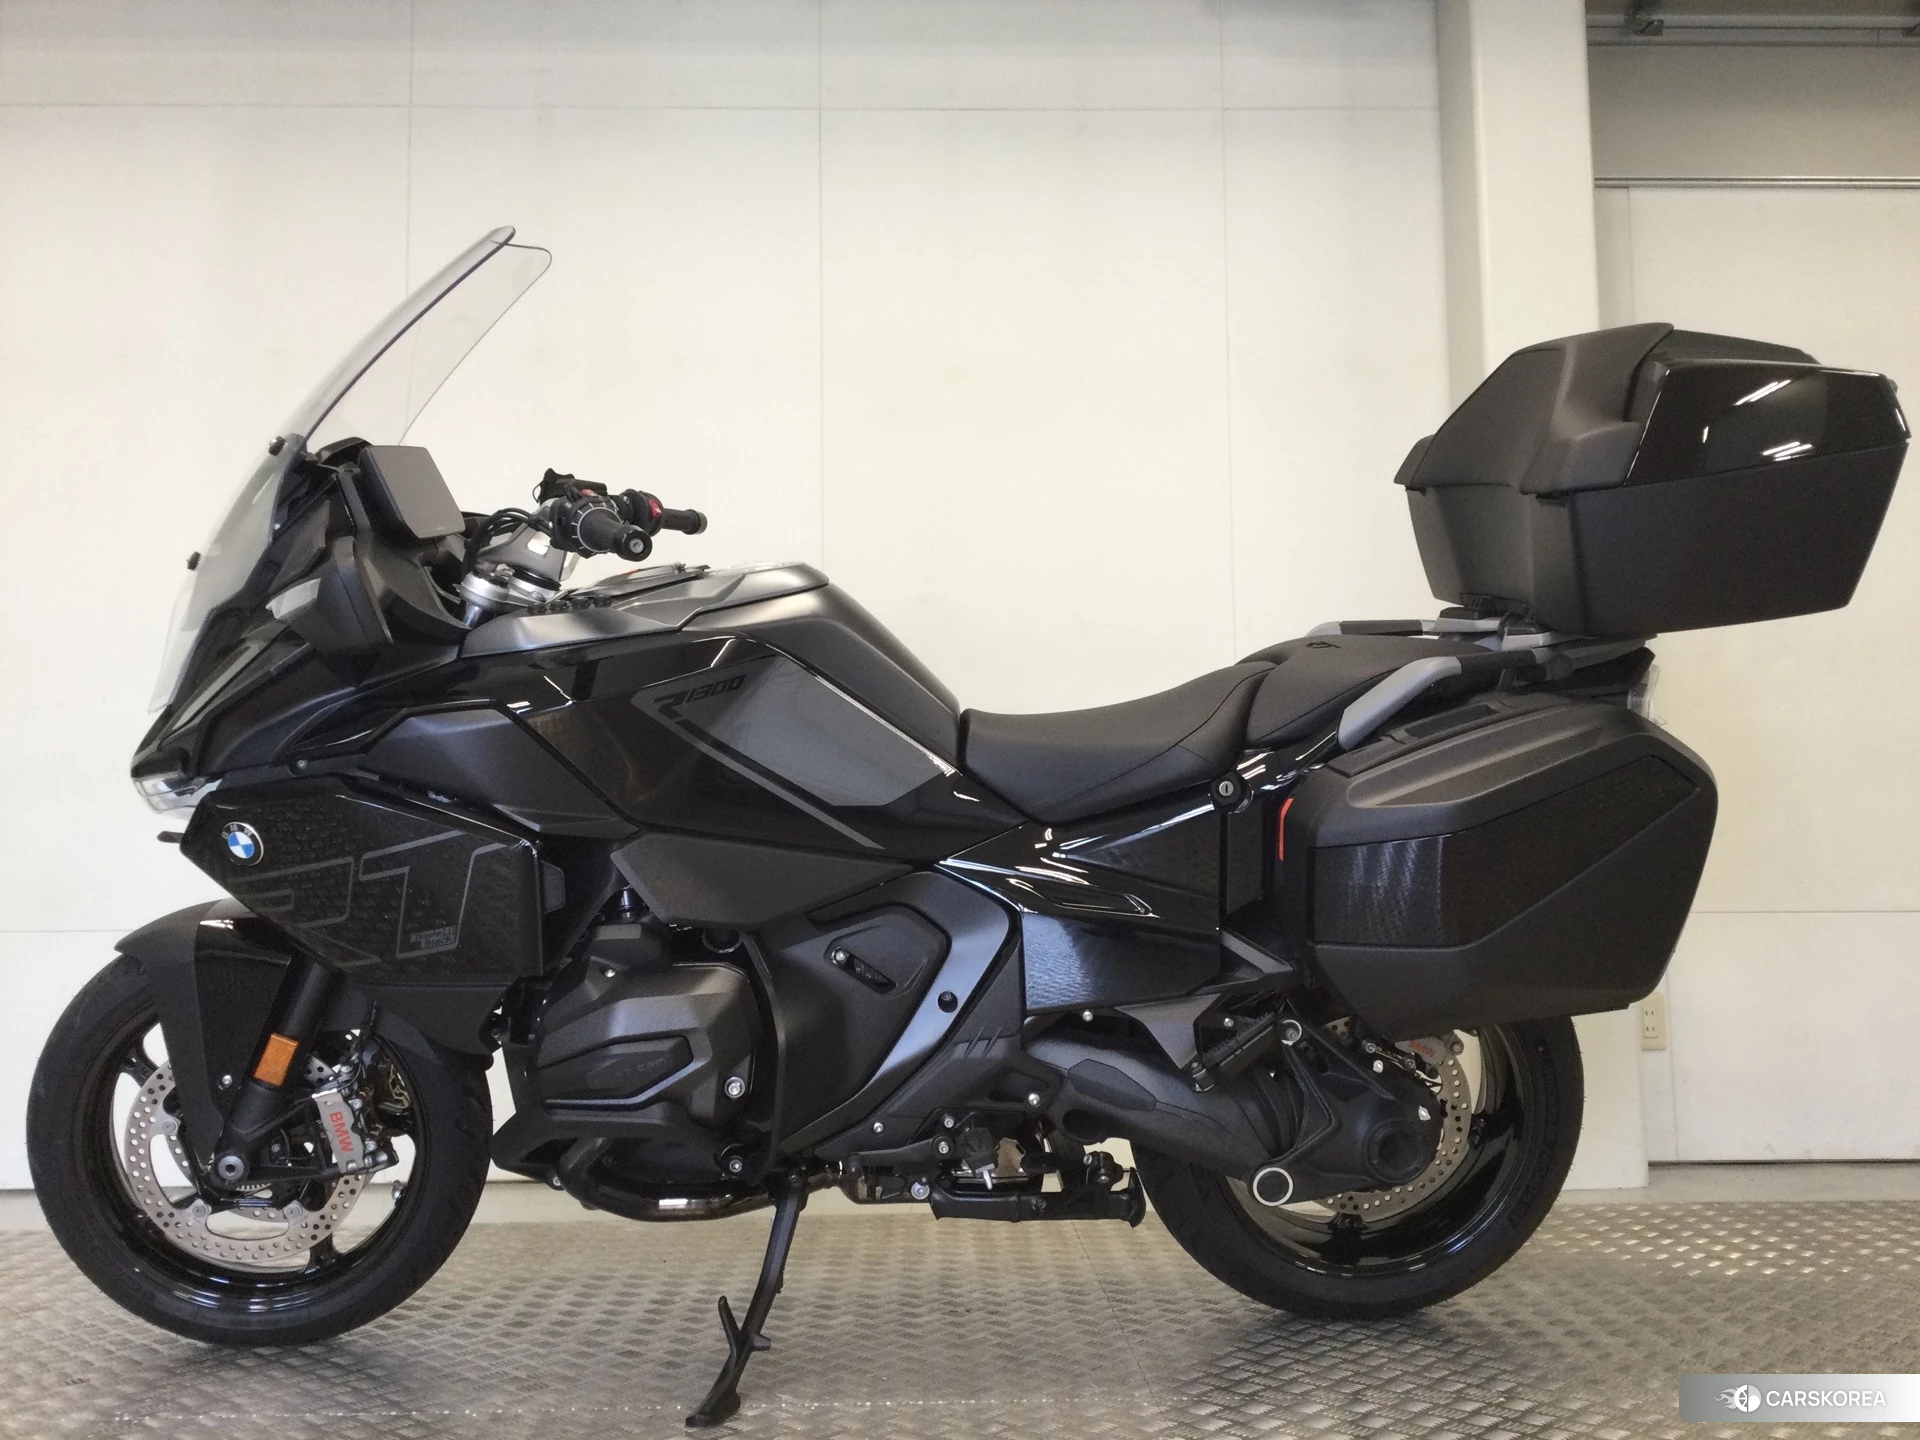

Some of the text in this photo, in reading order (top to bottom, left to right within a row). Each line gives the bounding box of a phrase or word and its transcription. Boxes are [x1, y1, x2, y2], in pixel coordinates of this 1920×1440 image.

[221, 823, 253, 840] BMW
[1408, 1039, 1437, 1057] BMW
[330, 1111, 354, 1152] BMW
